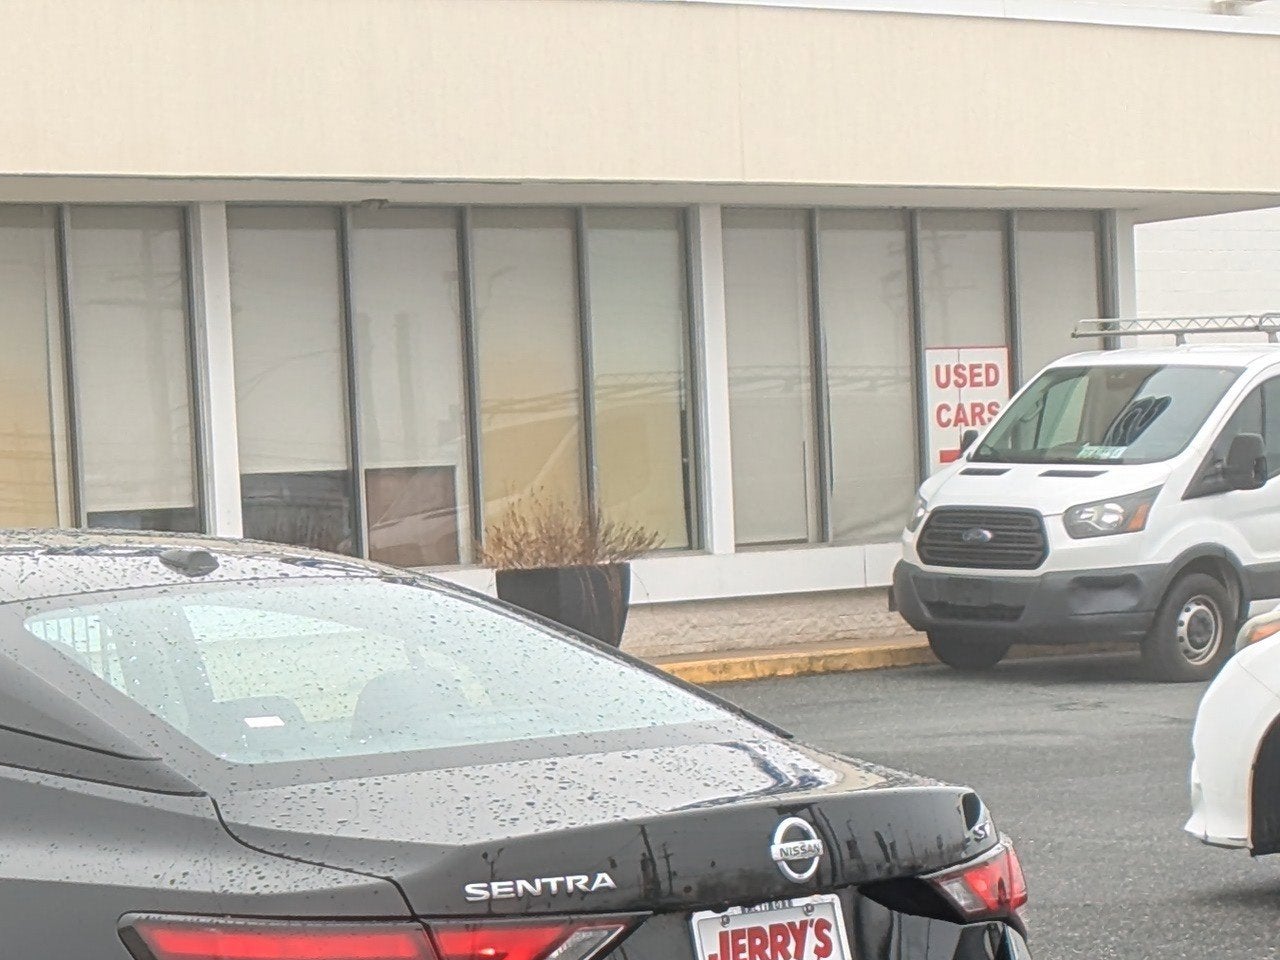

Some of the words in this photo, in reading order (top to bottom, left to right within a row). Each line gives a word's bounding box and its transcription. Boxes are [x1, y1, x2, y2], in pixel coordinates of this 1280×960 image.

[935, 363, 1000, 389] USED
[936, 401, 1001, 428] CARS
[780, 843, 821, 857] NISSAN
[464, 872, 618, 902] SENTRA
